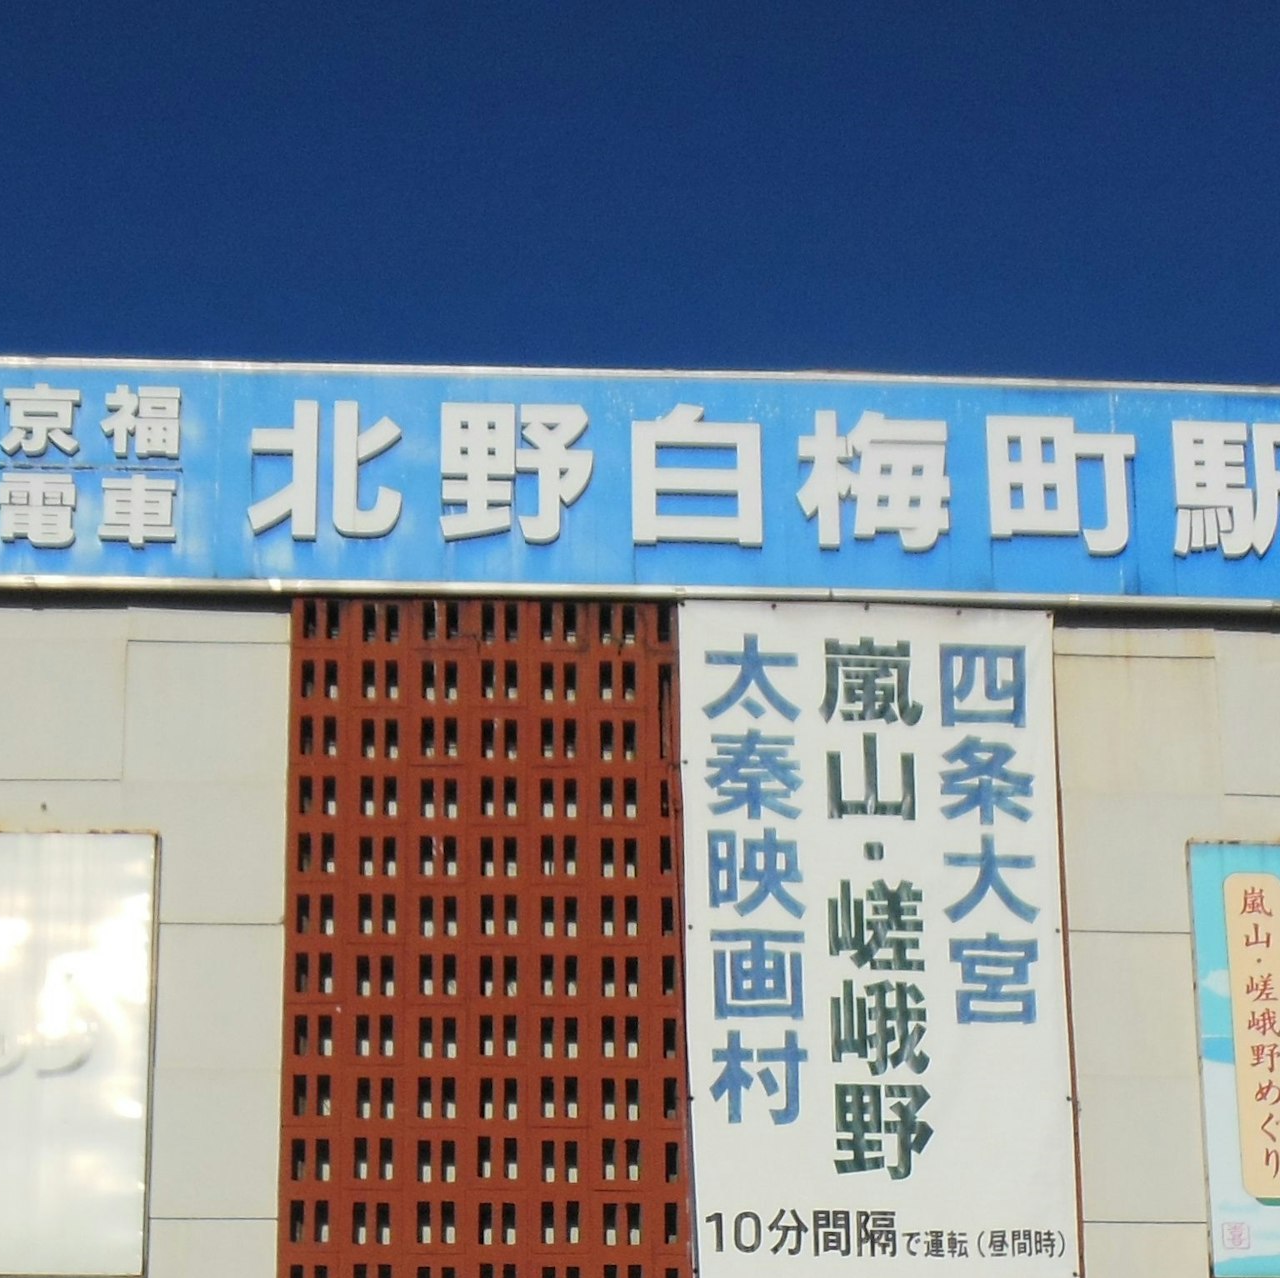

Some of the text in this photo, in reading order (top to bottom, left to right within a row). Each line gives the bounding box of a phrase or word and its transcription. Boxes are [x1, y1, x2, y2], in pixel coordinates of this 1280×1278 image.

[0, 471, 179, 551] 電車
[1, 384, 181, 459] 京福
[703, 632, 808, 1126] 太秦映画村
[819, 636, 935, 1181] 嵐山・嵯峨野
[938, 642, 1041, 1026] 四条大宮
